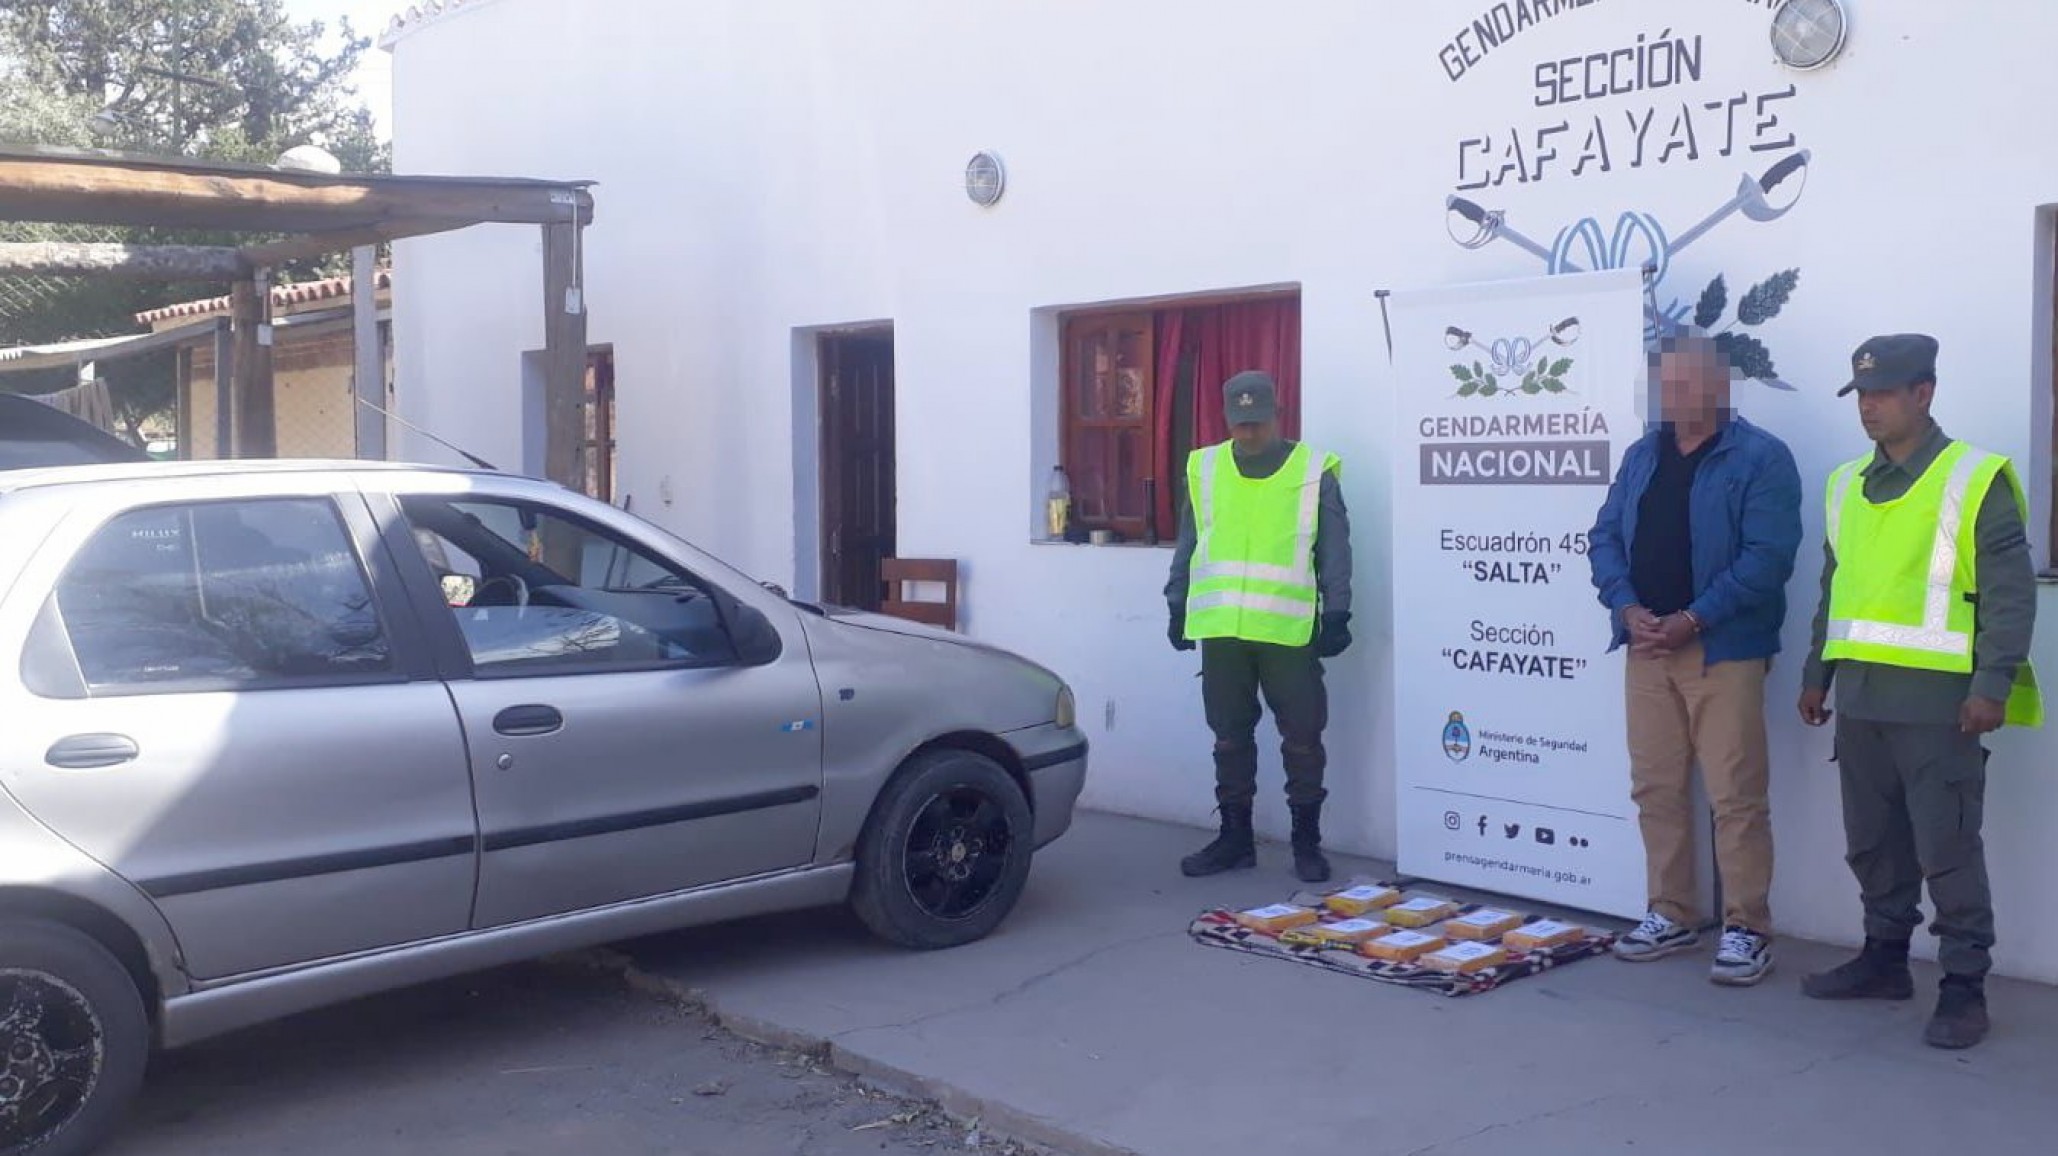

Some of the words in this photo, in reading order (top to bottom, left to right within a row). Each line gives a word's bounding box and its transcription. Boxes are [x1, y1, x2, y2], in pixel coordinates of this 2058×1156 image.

[1439, 0, 1601, 82] GENDAR
[1456, 83, 1797, 190] CAFAYATE
[1419, 405, 1609, 438] GENDARMERÍA
[1431, 449, 1601, 478] NACIONAL
[1441, 529, 1551, 553] Escuadrón
[1558, 533, 1587, 555] 45
[1470, 619, 1554, 647] Sección
[1479, 730, 1524, 745] Ministerio
[1526, 734, 1538, 746] de
[1479, 745, 1540, 764] Argentina
